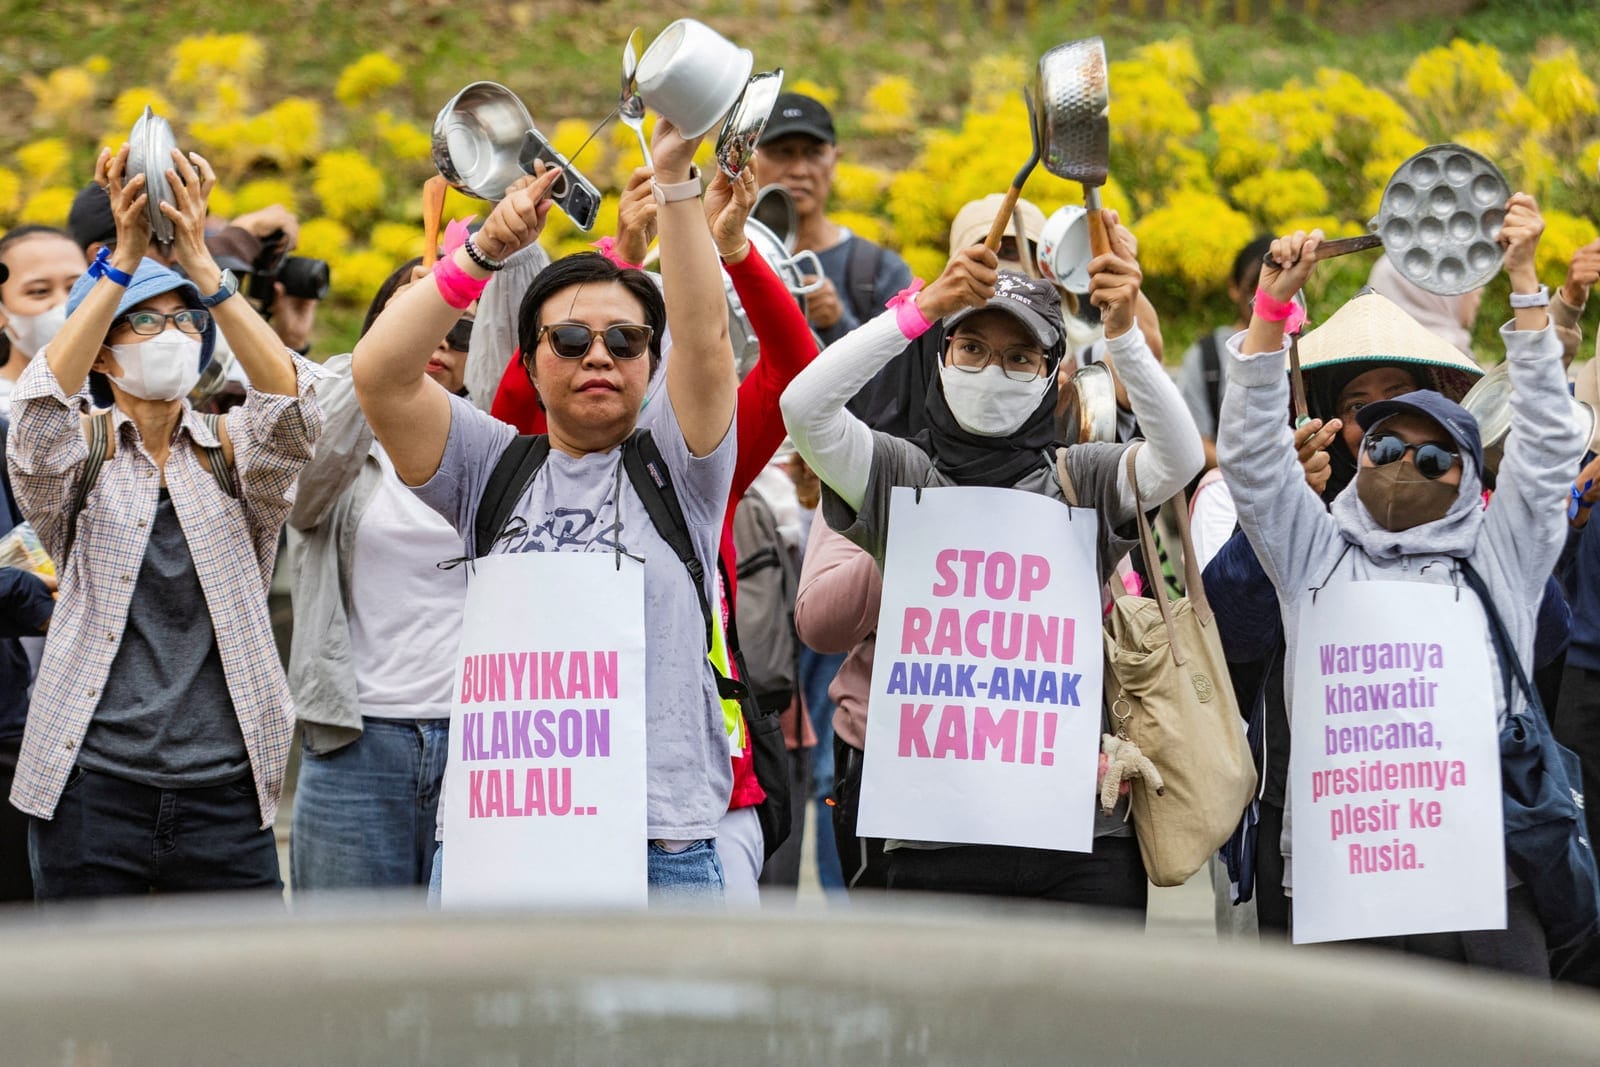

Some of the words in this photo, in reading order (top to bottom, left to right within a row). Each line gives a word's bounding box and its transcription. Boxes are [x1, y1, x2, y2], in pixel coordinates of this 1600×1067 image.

[932, 548, 1051, 602] STOP
[900, 607, 1075, 665] RACUNI
[1320, 642, 1444, 676] Warganya
[461, 651, 619, 704] BUNYIKAN
[886, 661, 1082, 707] ANAK-ANAK
[1325, 676, 1438, 715] khawatir
[462, 710, 610, 761] KLAKSON
[898, 703, 1058, 767] KAMI!
[1325, 721, 1442, 756] bencana,
[469, 767, 598, 819] KALAU..
[1312, 760, 1466, 803] presidennya
[1330, 798, 1400, 841] plesir
[1409, 798, 1442, 829] ke
[1349, 838, 1425, 875] Rusia.
